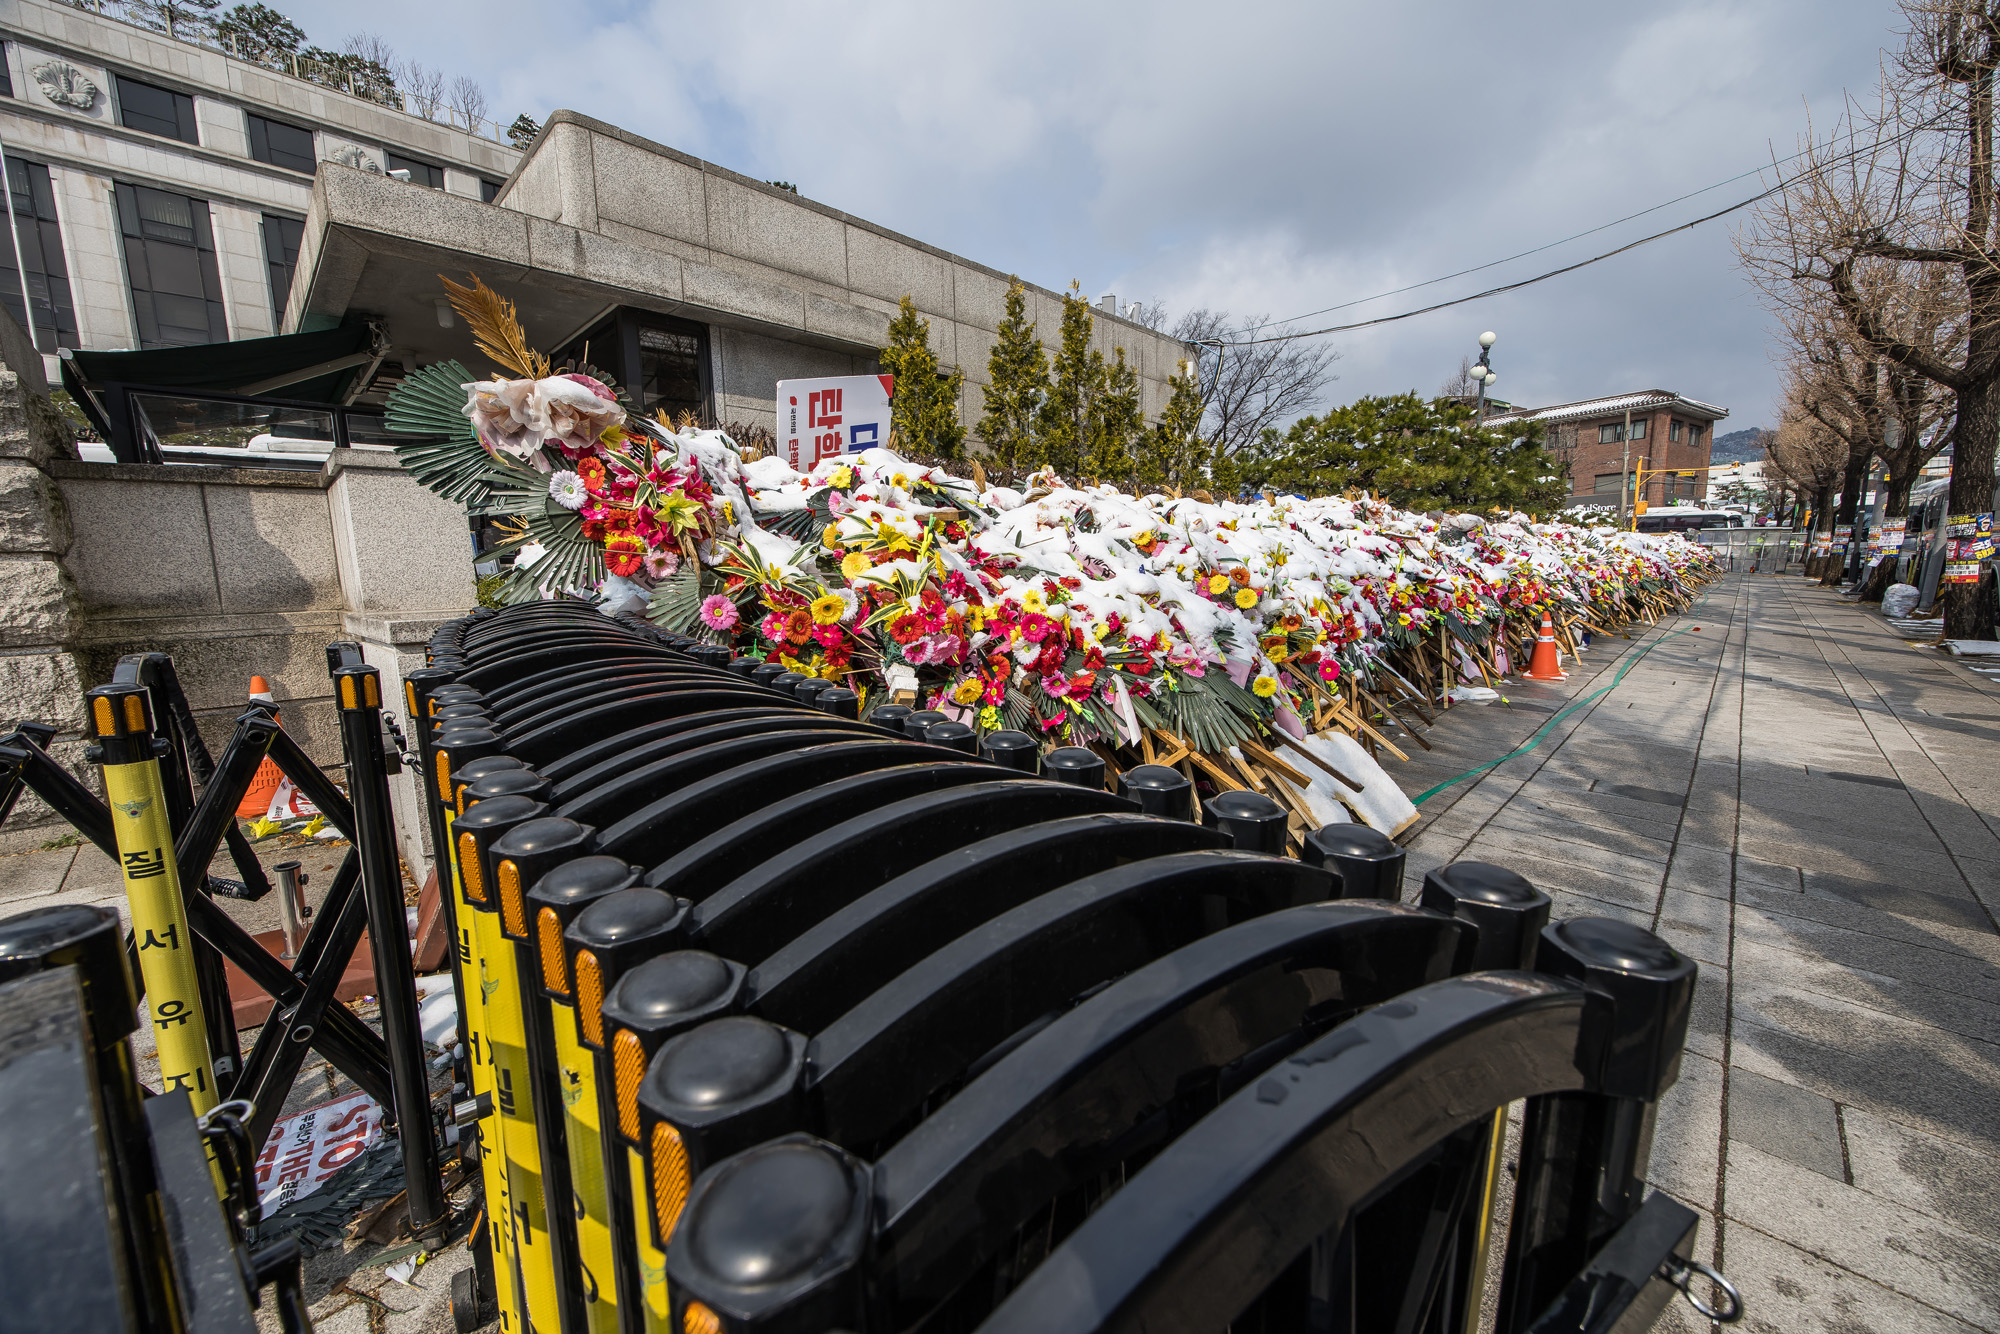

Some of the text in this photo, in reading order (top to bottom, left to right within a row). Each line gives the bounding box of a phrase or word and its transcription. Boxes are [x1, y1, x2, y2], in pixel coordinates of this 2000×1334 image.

[808, 388, 842, 471] 탄핵
[294, 1113, 316, 1147] 부정선거
[277, 1140, 315, 1186] THE
